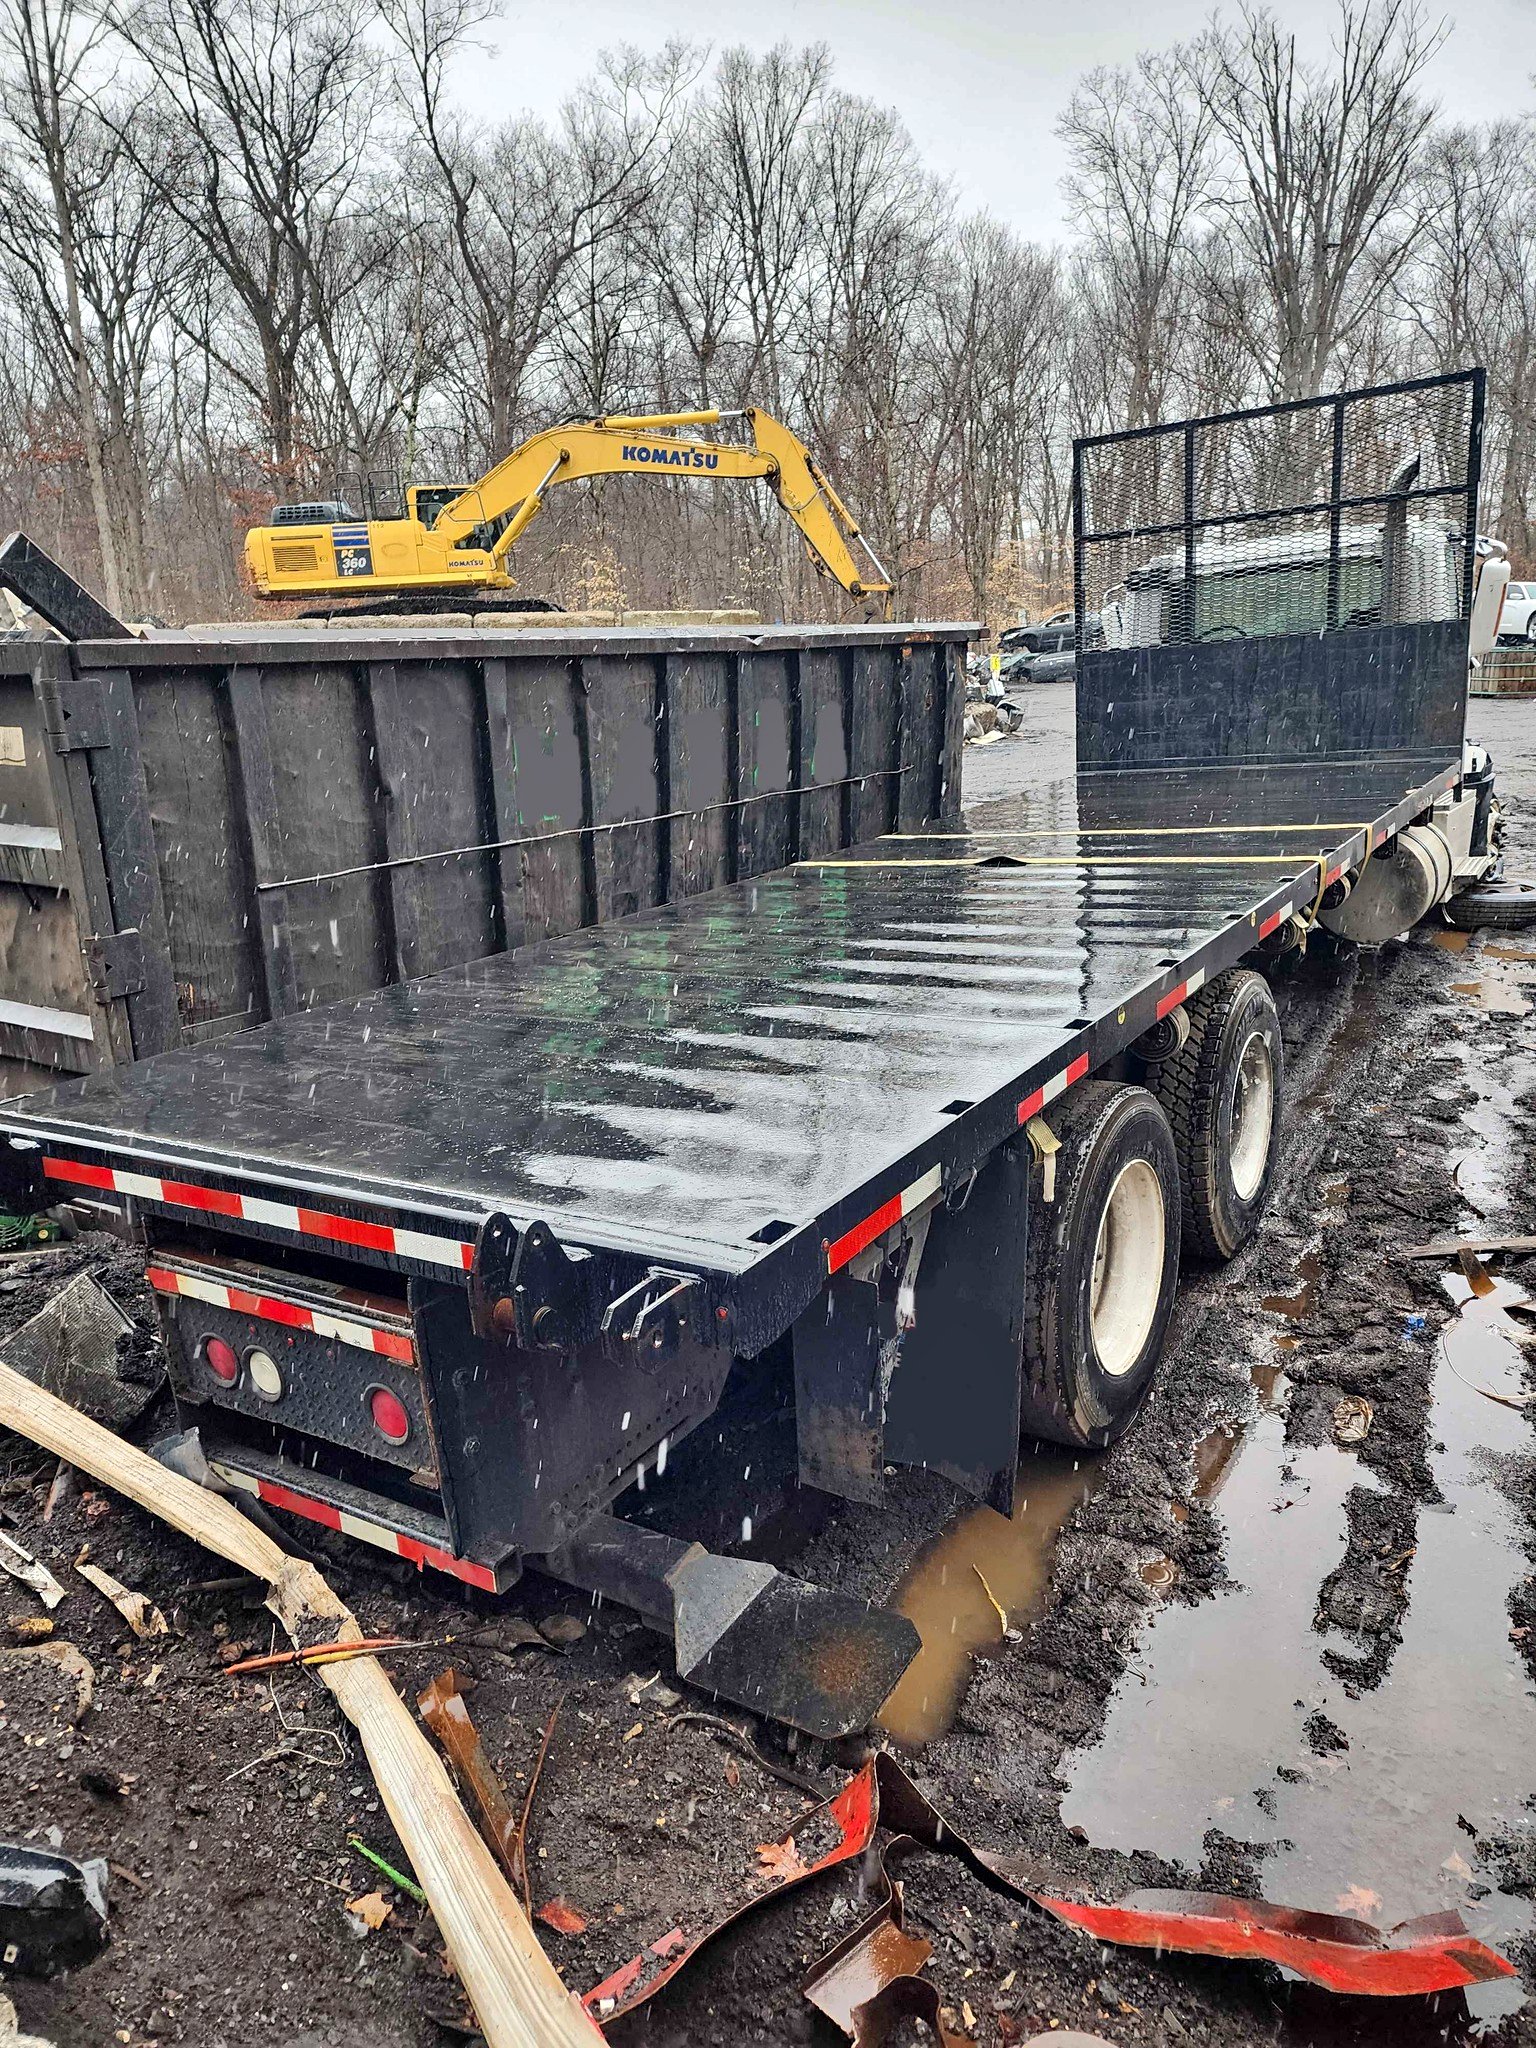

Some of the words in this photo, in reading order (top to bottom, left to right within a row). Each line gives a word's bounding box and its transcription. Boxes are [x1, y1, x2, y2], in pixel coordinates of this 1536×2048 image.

[622, 445, 718, 469] KOMATSU
[341, 549, 354, 559] PC
[342, 556, 367, 569] 360
[448, 559, 484, 567] KOMATSU
[343, 568, 354, 576] LC
